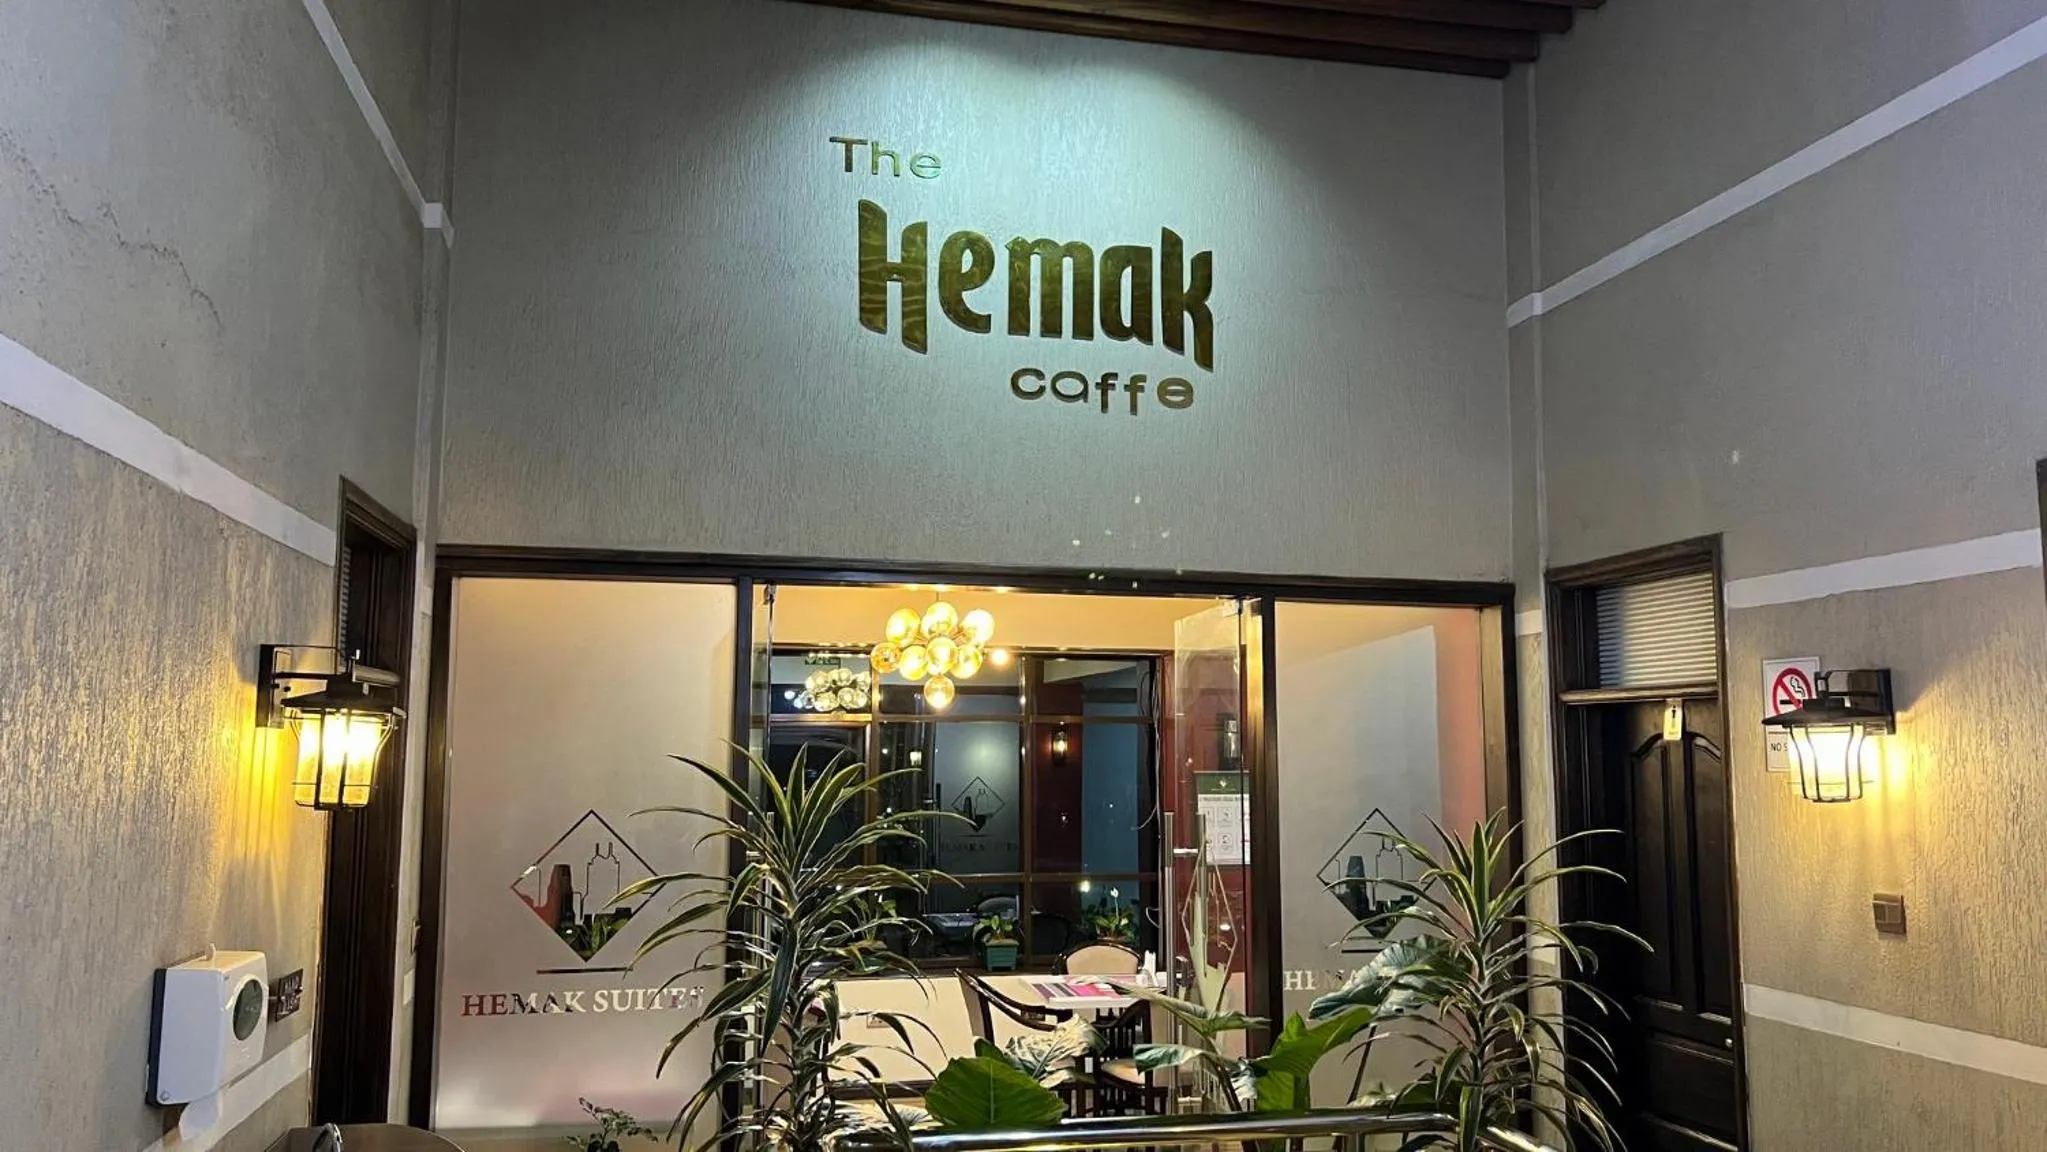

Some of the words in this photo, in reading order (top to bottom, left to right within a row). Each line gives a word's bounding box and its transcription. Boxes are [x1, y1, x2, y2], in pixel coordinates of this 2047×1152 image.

[829, 136, 942, 179] The
[858, 199, 1214, 372] Hemak
[1010, 367, 1195, 416] caffe
[461, 991, 587, 1016] HEMAK
